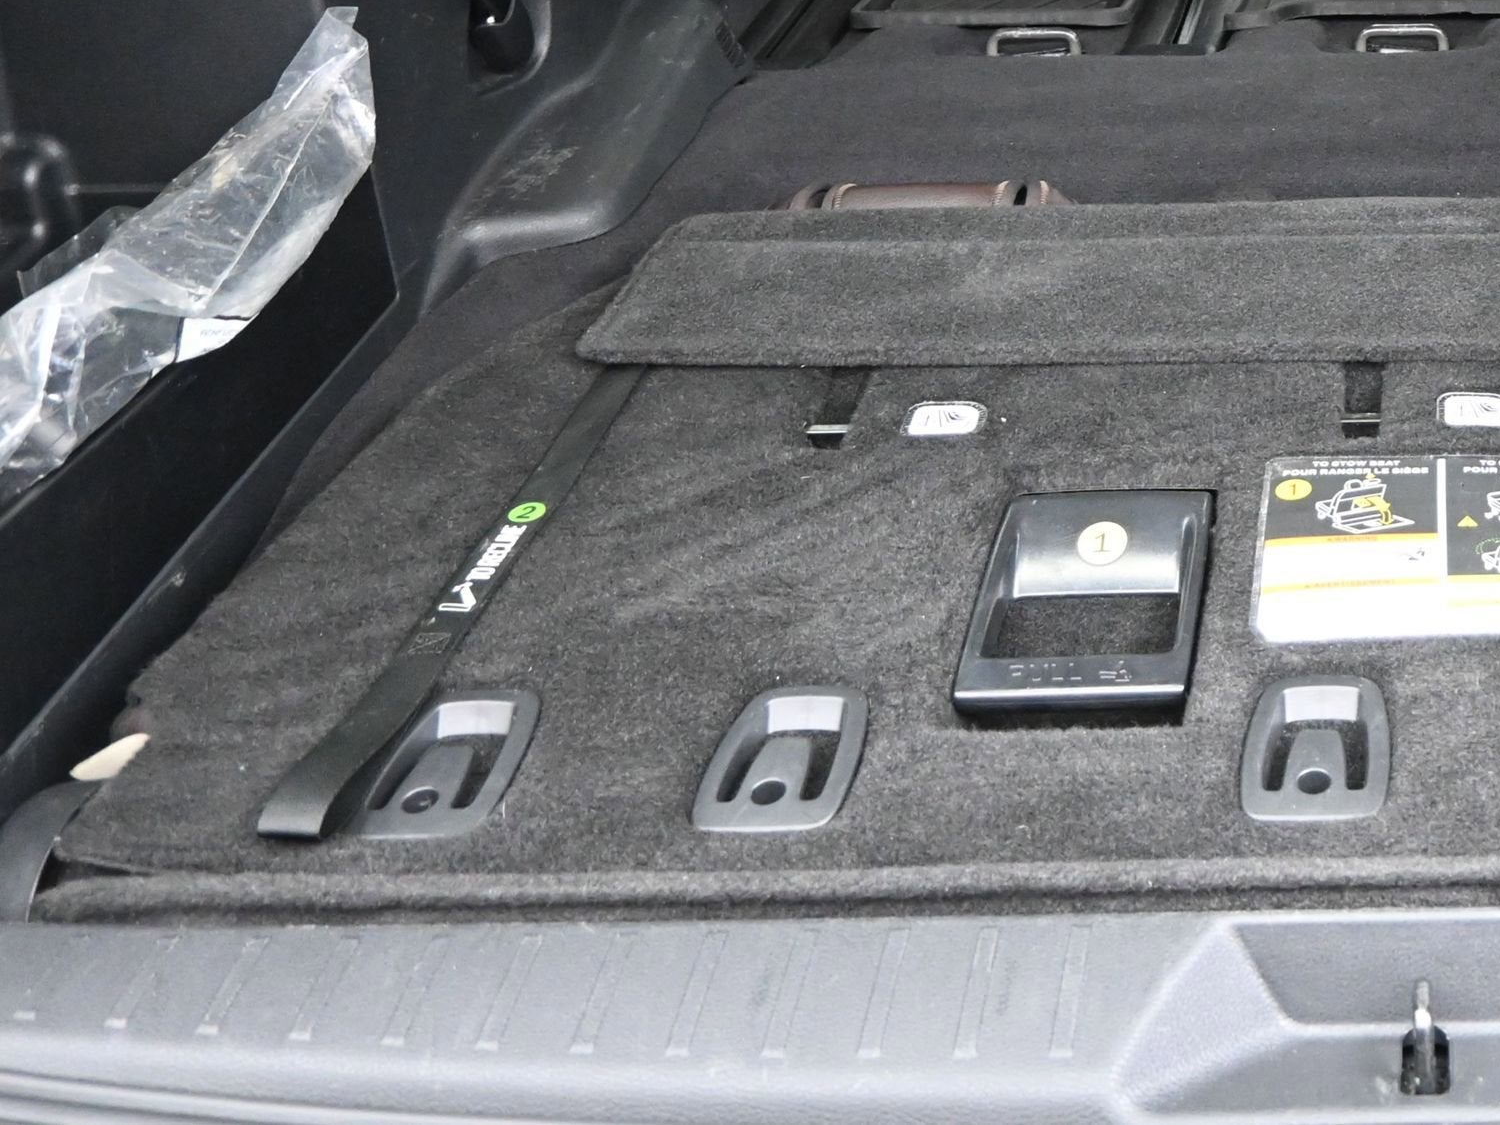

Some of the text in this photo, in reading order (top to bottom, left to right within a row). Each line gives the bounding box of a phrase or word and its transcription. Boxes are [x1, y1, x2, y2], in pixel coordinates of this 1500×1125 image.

[1331, 459, 1367, 467] STOW
[1369, 459, 1401, 467] SEAT
[1282, 469, 1317, 477] POUR
[1319, 468, 1371, 476] RANGER
[1373, 467, 1390, 475] LE
[1462, 466, 1498, 474] POUR
